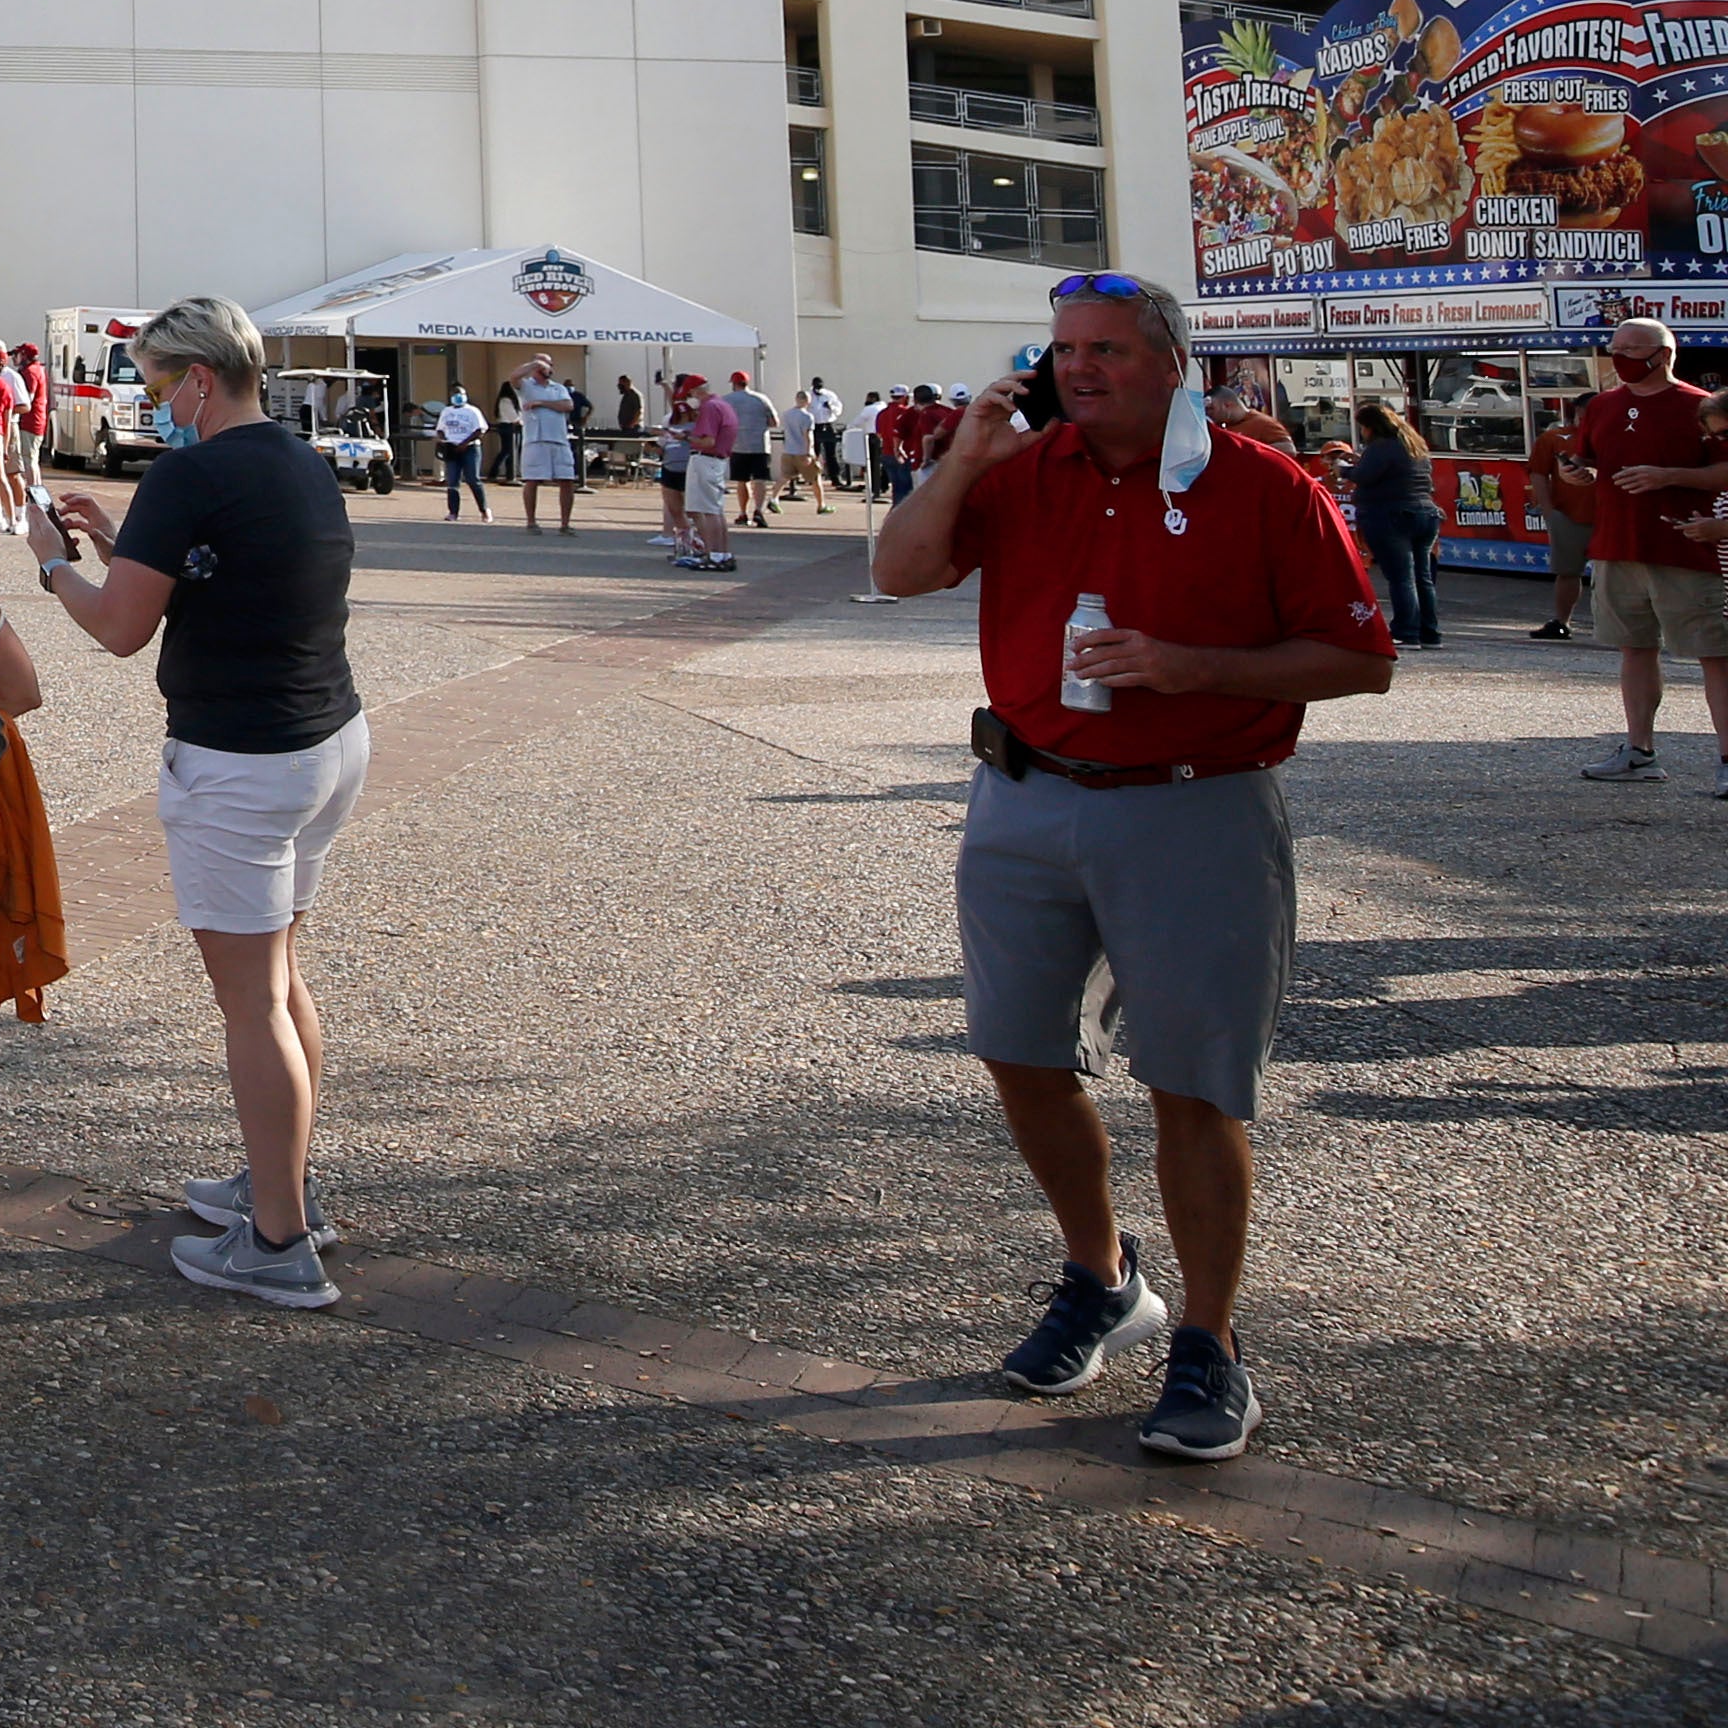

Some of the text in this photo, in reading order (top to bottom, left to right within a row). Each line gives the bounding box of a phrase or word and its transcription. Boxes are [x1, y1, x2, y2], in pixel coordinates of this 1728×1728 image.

[1331, 23, 1362, 40] Chicken
[1317, 32, 1388, 78] KABOBS
[1448, 20, 1622, 100] FRIED FAVORITES!
[1193, 72, 1305, 125] TASTY TREATS!
[1503, 78, 1629, 112] FRESH CUT FRIES
[1194, 118, 1285, 151] PINEAPPLE BOWL
[1475, 197, 1556, 226] CHICKEN
[1348, 218, 1450, 252] RIBBON FRIES
[1467, 230, 1641, 261] DONUT SANDWICH
[1203, 238, 1335, 279] SHRIMP PO'BOY
[514, 271, 593, 292] RED RIVER
[520, 281, 587, 295] SHOWDOWN
[1202, 311, 1234, 330] GRILLED
[1236, 310, 1271, 330] CHICKEN
[1330, 299, 1542, 326] FRESH CUTS FRIES & FRESH LEMONADE!
[1633, 295, 1726, 319] GET FRIED!
[418, 323, 476, 338] MEDIA
[493, 326, 588, 341] HANDICAP
[593, 329, 694, 343] ENTRANCE
[1456, 511, 1506, 525] LEMONADE
